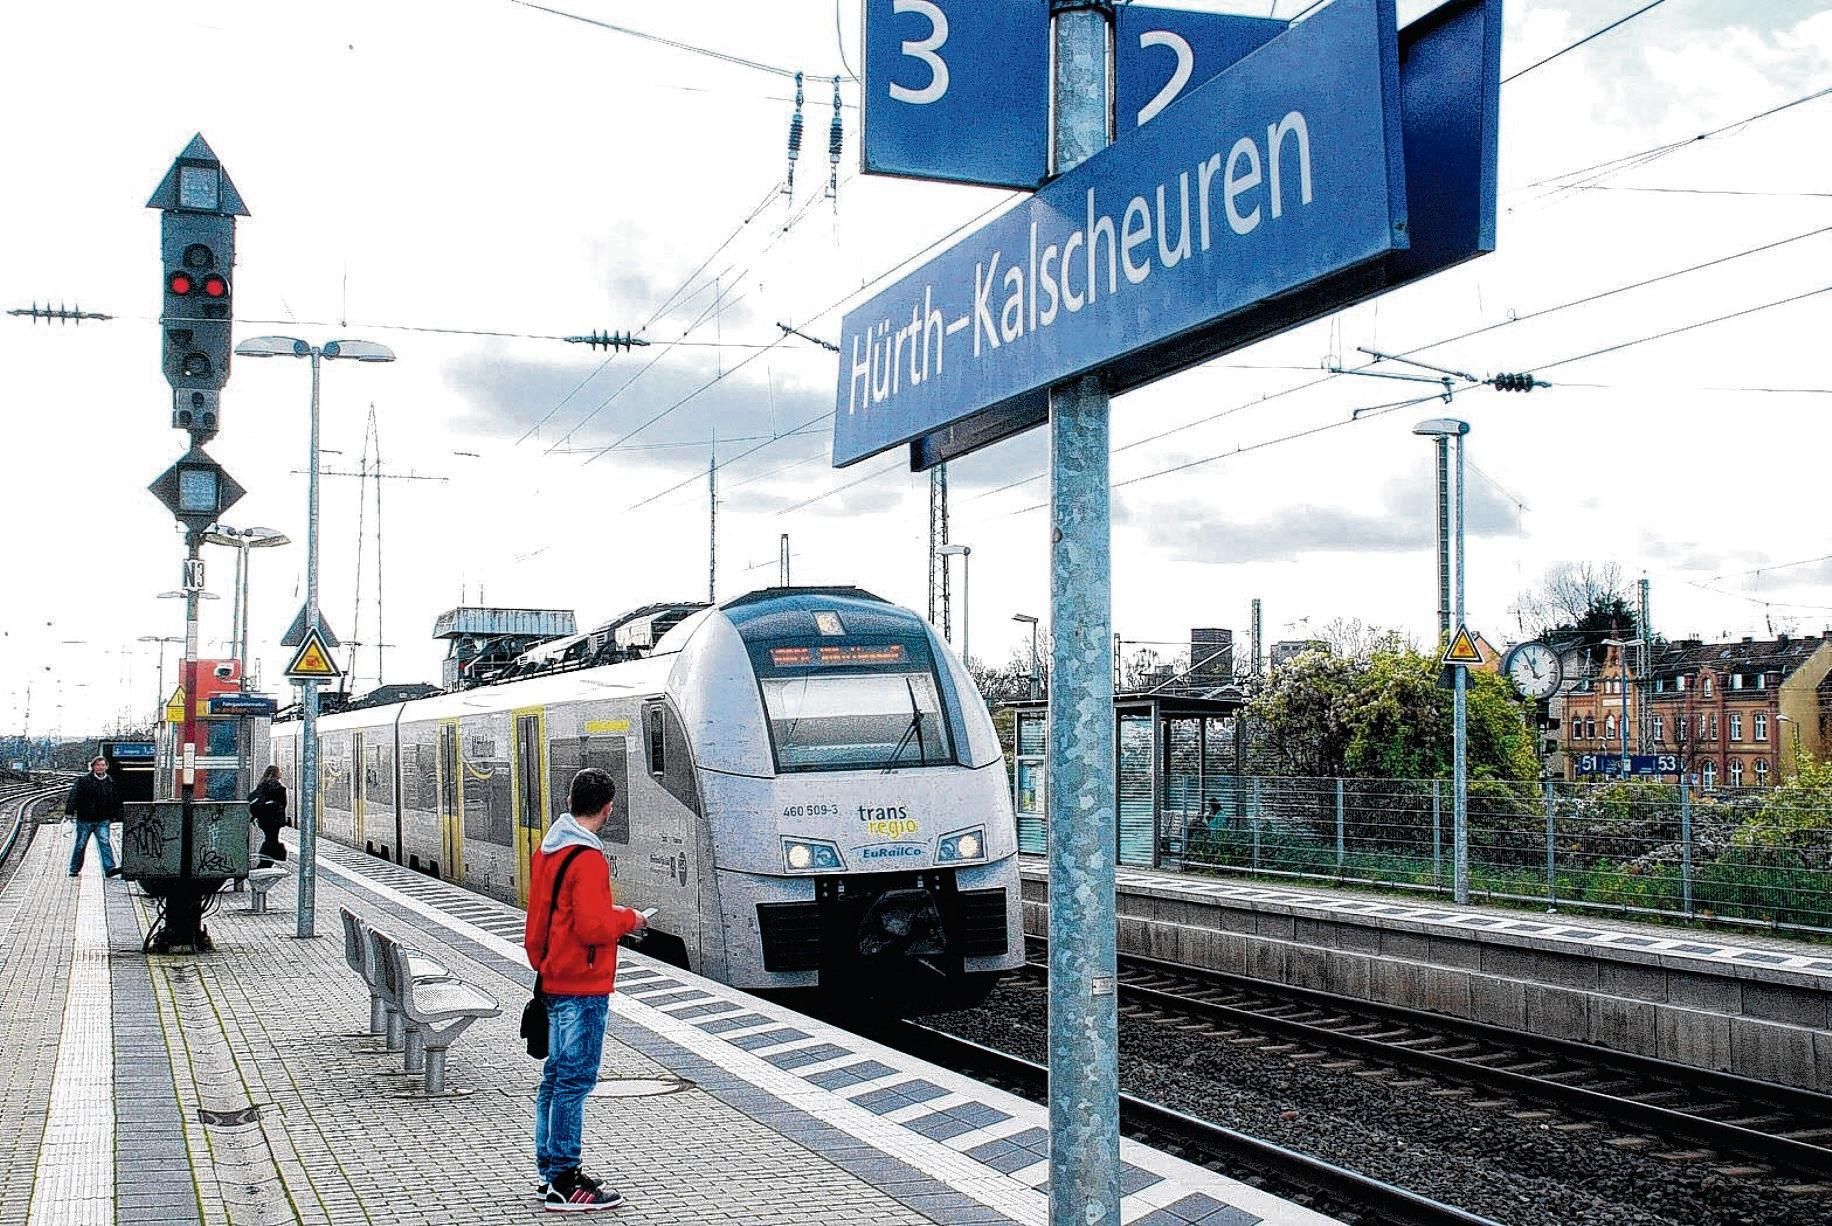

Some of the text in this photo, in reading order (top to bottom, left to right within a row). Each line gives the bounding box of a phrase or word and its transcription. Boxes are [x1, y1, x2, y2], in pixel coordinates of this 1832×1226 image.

[889, 0, 950, 104] 3
[849, 110, 1312, 415] Hürth-Kalscheuren
[184, 561, 205, 588] N3
[1582, 755, 1597, 771] 51
[1658, 755, 1676, 771] 53
[783, 804, 839, 817] 460 509-3
[857, 804, 908, 821] trans
[868, 819, 917, 839] regio
[863, 846, 922, 859] EuRailCo
